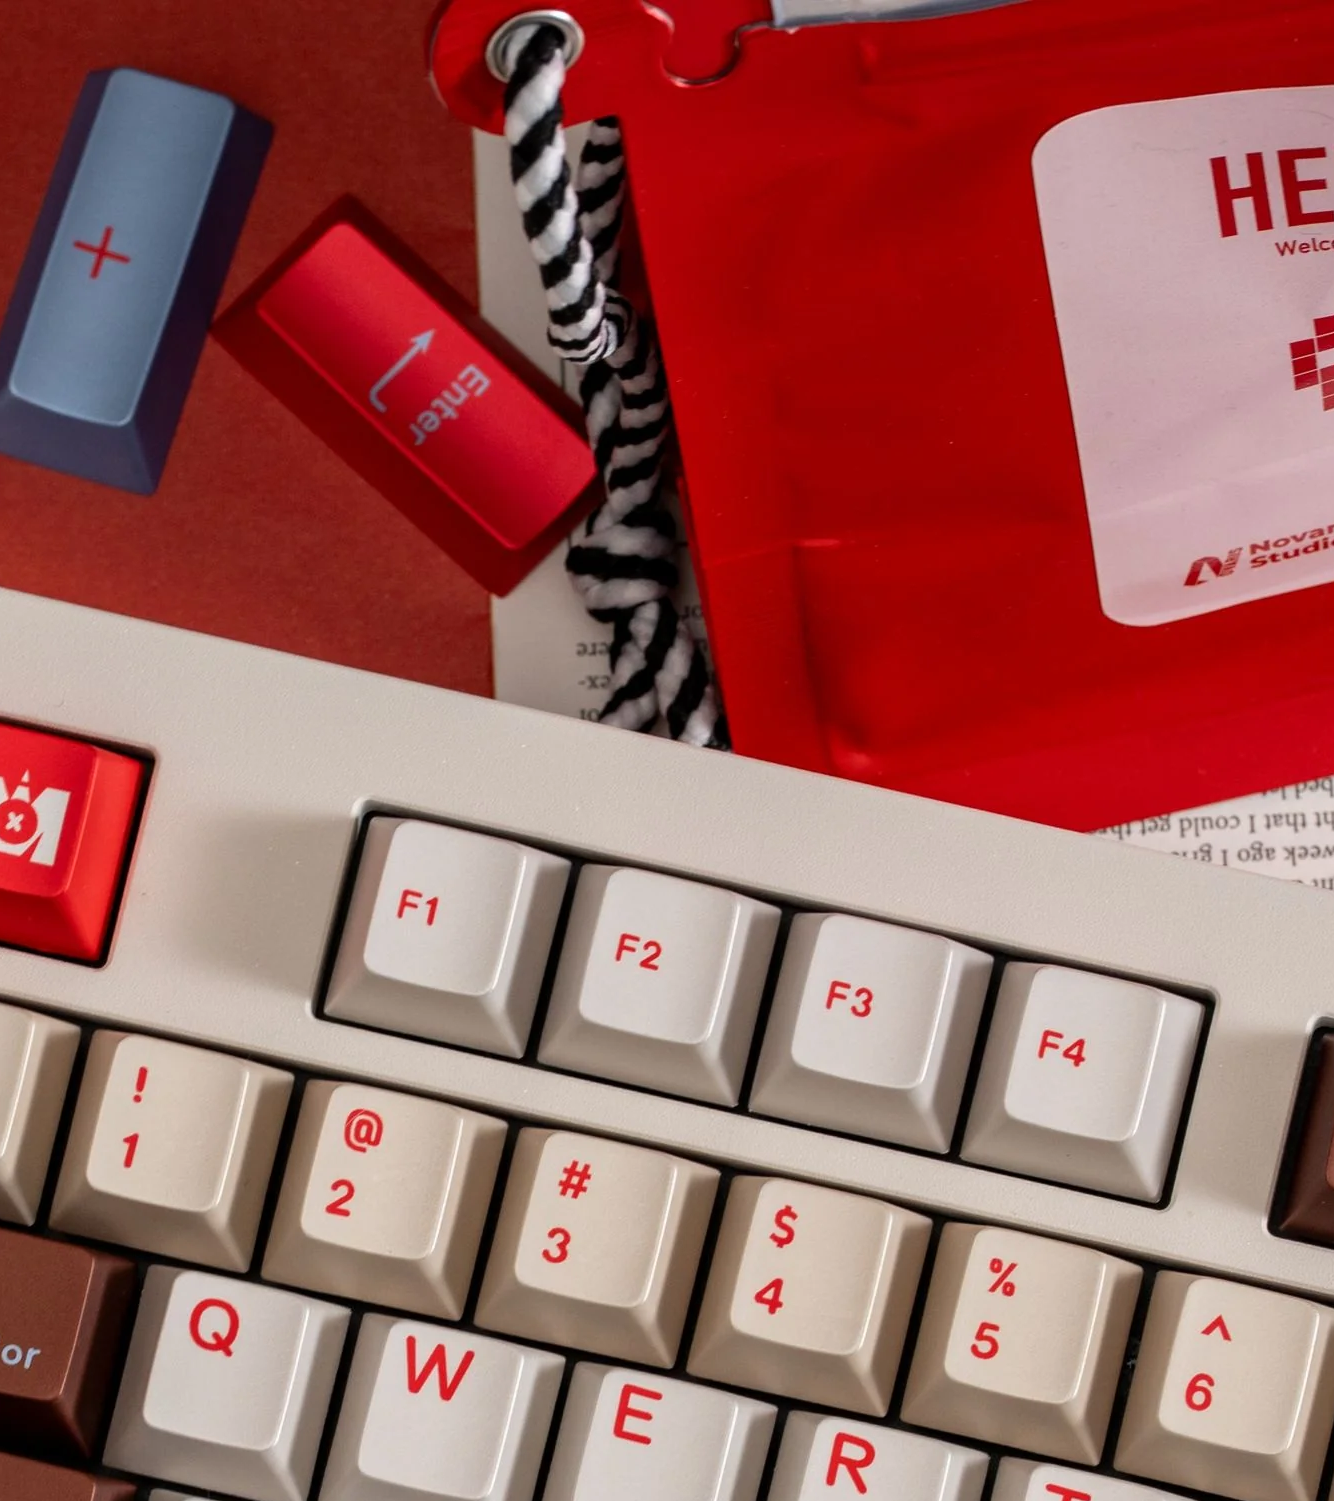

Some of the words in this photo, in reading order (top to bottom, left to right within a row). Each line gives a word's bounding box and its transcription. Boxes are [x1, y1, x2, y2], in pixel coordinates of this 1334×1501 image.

[409, 365, 491, 445] Enter
[397, 889, 439, 925] F1
[616, 933, 662, 970] F2
[826, 981, 873, 1018] F3
[1038, 1030, 1085, 1067] F4
[133, 1067, 148, 1103] !
[344, 1109, 383, 1152] @
[124, 1133, 139, 1168] 1
[325, 1179, 355, 1217] 2
[559, 1160, 591, 1199] #
[542, 1227, 571, 1263] 3
[770, 1205, 797, 1248] $
[989, 1258, 1017, 1296] %
[754, 1278, 783, 1315] 4
[189, 1298, 240, 1357] Q
[971, 1321, 999, 1360] 5
[1202, 1315, 1231, 1341] ^
[406, 1336, 475, 1401] W
[1185, 1373, 1214, 1411] 6
[613, 1384, 663, 1445] E
[826, 1432, 875, 1494] R
